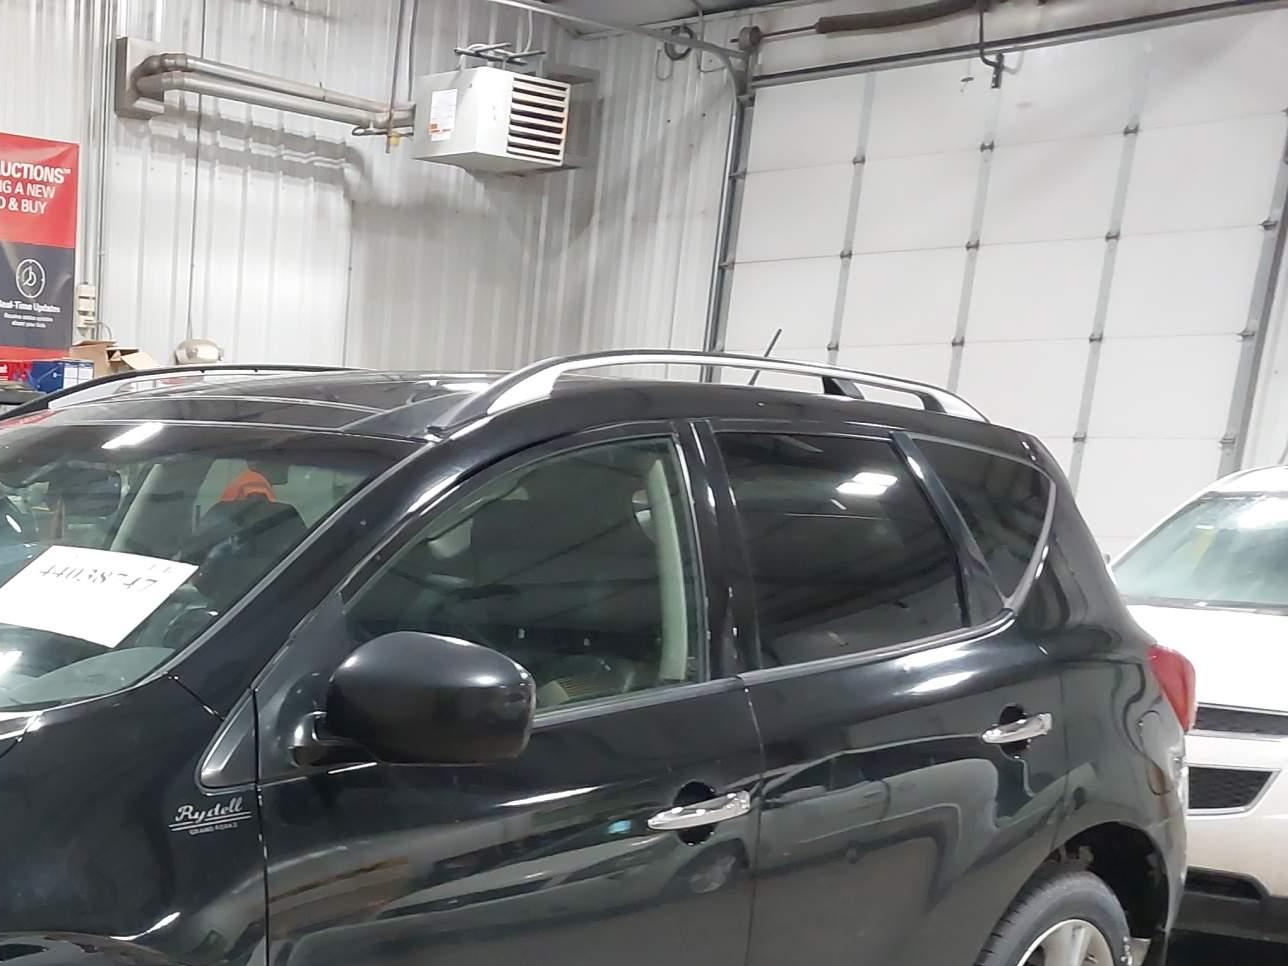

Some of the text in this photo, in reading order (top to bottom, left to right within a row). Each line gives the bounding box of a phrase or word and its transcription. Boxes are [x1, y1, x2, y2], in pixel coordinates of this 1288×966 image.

[14, 182, 25, 196] A
[26, 183, 56, 199] NEW
[7, 197, 19, 211] &
[21, 199, 48, 214] BUY
[33, 302, 61, 313] Updates
[175, 796, 243, 823] Rydell
